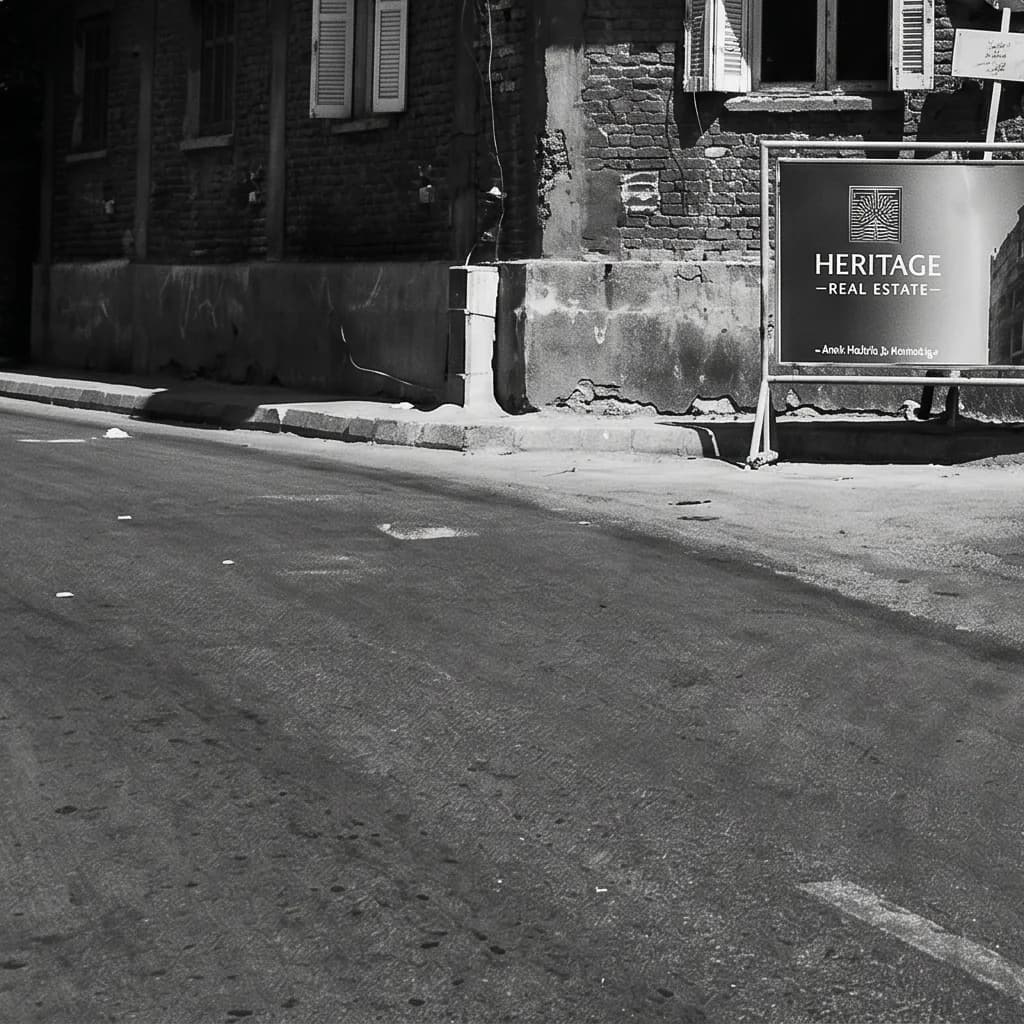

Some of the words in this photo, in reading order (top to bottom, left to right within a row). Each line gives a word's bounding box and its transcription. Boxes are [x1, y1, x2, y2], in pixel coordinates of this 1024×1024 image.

[815, 253, 942, 276] HERITAGE
[828, 282, 867, 295] REAL
[873, 283, 928, 296] ESTATE
